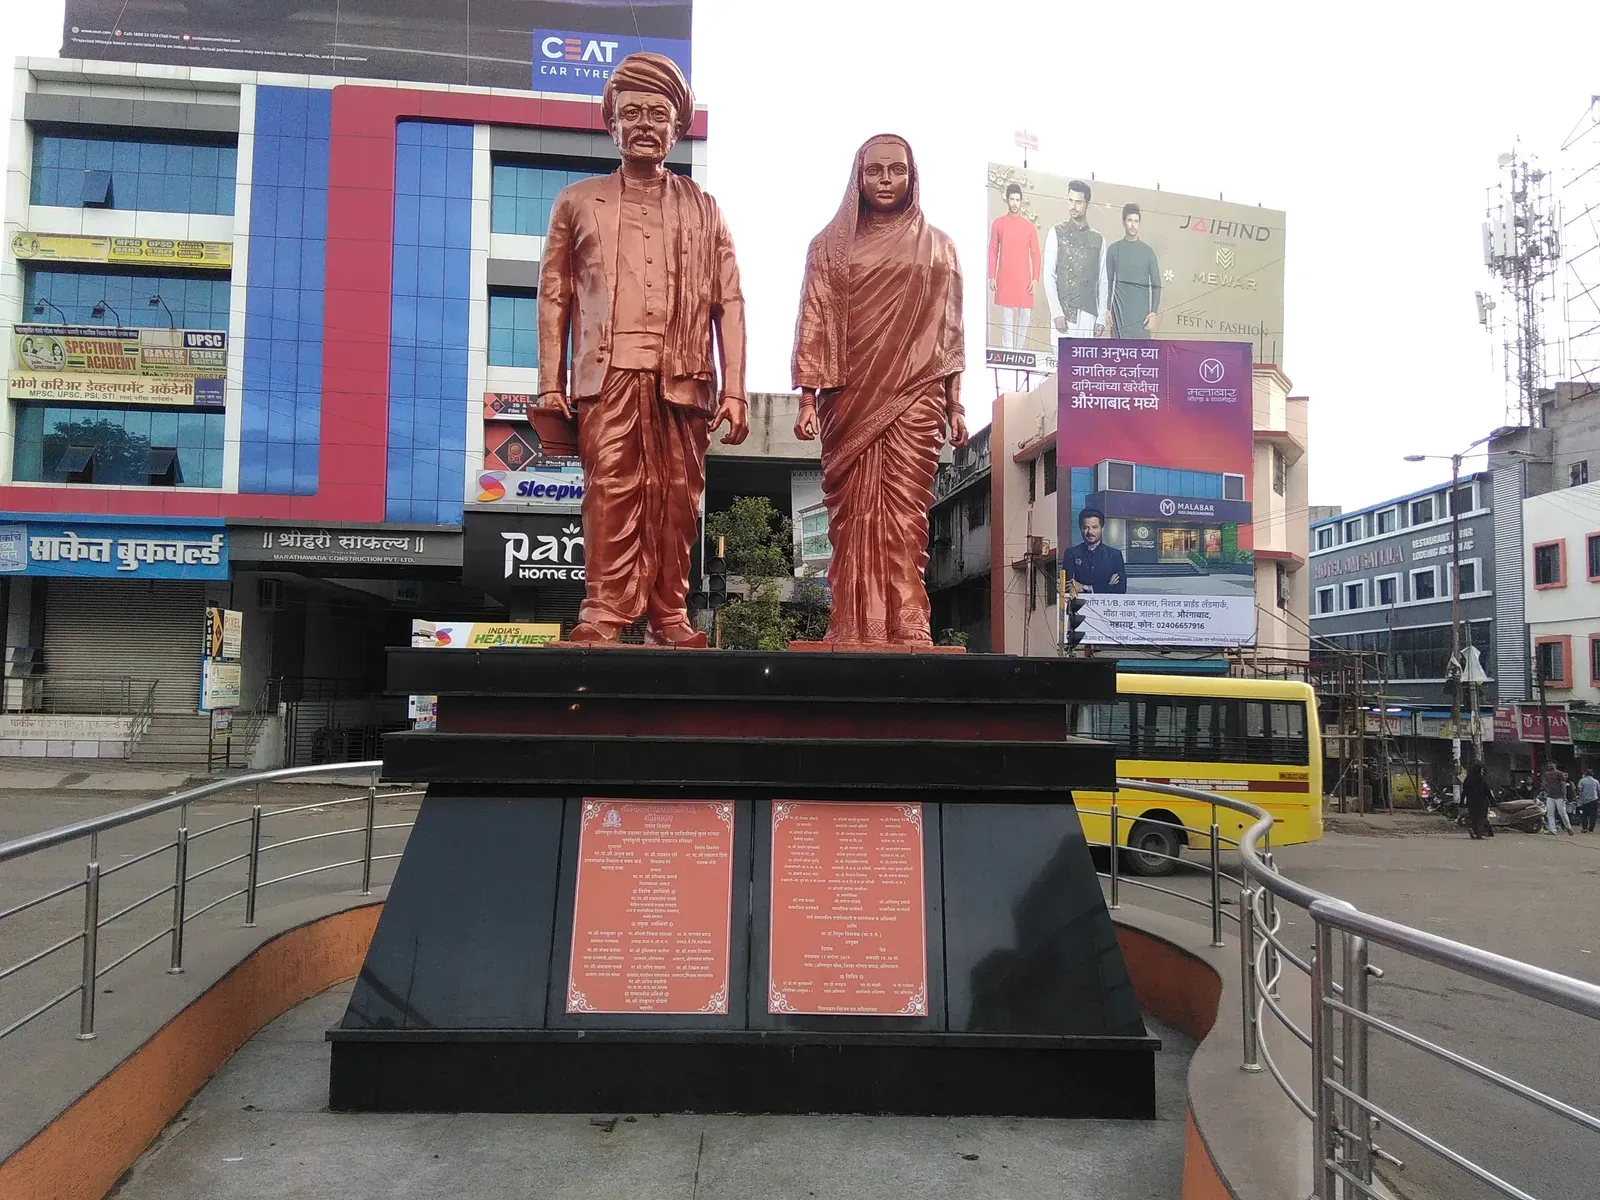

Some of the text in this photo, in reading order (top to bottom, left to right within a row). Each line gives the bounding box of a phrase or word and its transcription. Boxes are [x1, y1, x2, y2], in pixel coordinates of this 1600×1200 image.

[542, 37, 618, 63] CEAT
[541, 66, 567, 76] CAR
[1180, 215, 1271, 242] JAIHIND
[116, 239, 141, 247] MPSC
[1193, 272, 1257, 291] MEWAR
[1177, 315, 1202, 328] FEST
[1220, 321, 1268, 337] FASHION
[64, 338, 124, 356] SPECTRUM
[187, 334, 222, 347] UPSC
[143, 349, 224, 359] BANK STAFF
[987, 353, 1035, 365] JAIHIND
[1071, 346, 1099, 359] आता
[1101, 347, 1139, 363] अनुभव
[87, 356, 137, 371] ACADEMY
[1071, 363, 1159, 379] जागतिक दर्जाच्या
[11, 377, 37, 389] भोगे
[41, 378, 82, 392] करिअर
[86, 380, 144, 394] डेव्हलपमेंट
[1071, 379, 1159, 393] दागिन्यांच्या खरेदीचा
[1187, 388, 1237, 397] मलाबार
[29, 390, 55, 398] MPSC,
[58, 391, 82, 399] UPSC,
[85, 392, 100, 400] PSI,
[501, 395, 533, 404] PIXEL
[1071, 392, 1131, 411] औरंगाबाद
[1178, 503, 1215, 512] MALABAR
[278, 529, 332, 550] श्रीहरी
[338, 535, 410, 551] साफल्य
[1412, 533, 1451, 549] RESTAURANT
[30, 531, 224, 570] साकेत बुकवर्ल्ड
[1412, 548, 1439, 561] LODGING
[1439, 546, 1448, 556] AC
[1313, 560, 1343, 579] HOTEL
[1362, 551, 1378, 570] SAI
[520, 569, 567, 580] HOME
[1137, 600, 1159, 608] मजला,
[1161, 599, 1182, 607] निशाज
[1183, 599, 1200, 608] प्राईड
[1162, 610, 1175, 618] रोड,
[1177, 609, 1212, 620] औरंगाबाद,
[1137, 620, 1155, 629] फोन:
[1157, 622, 1205, 630] 02406657916
[474, 634, 556, 645] HEALTHIEST
[1534, 716, 1568, 727] TTAN
